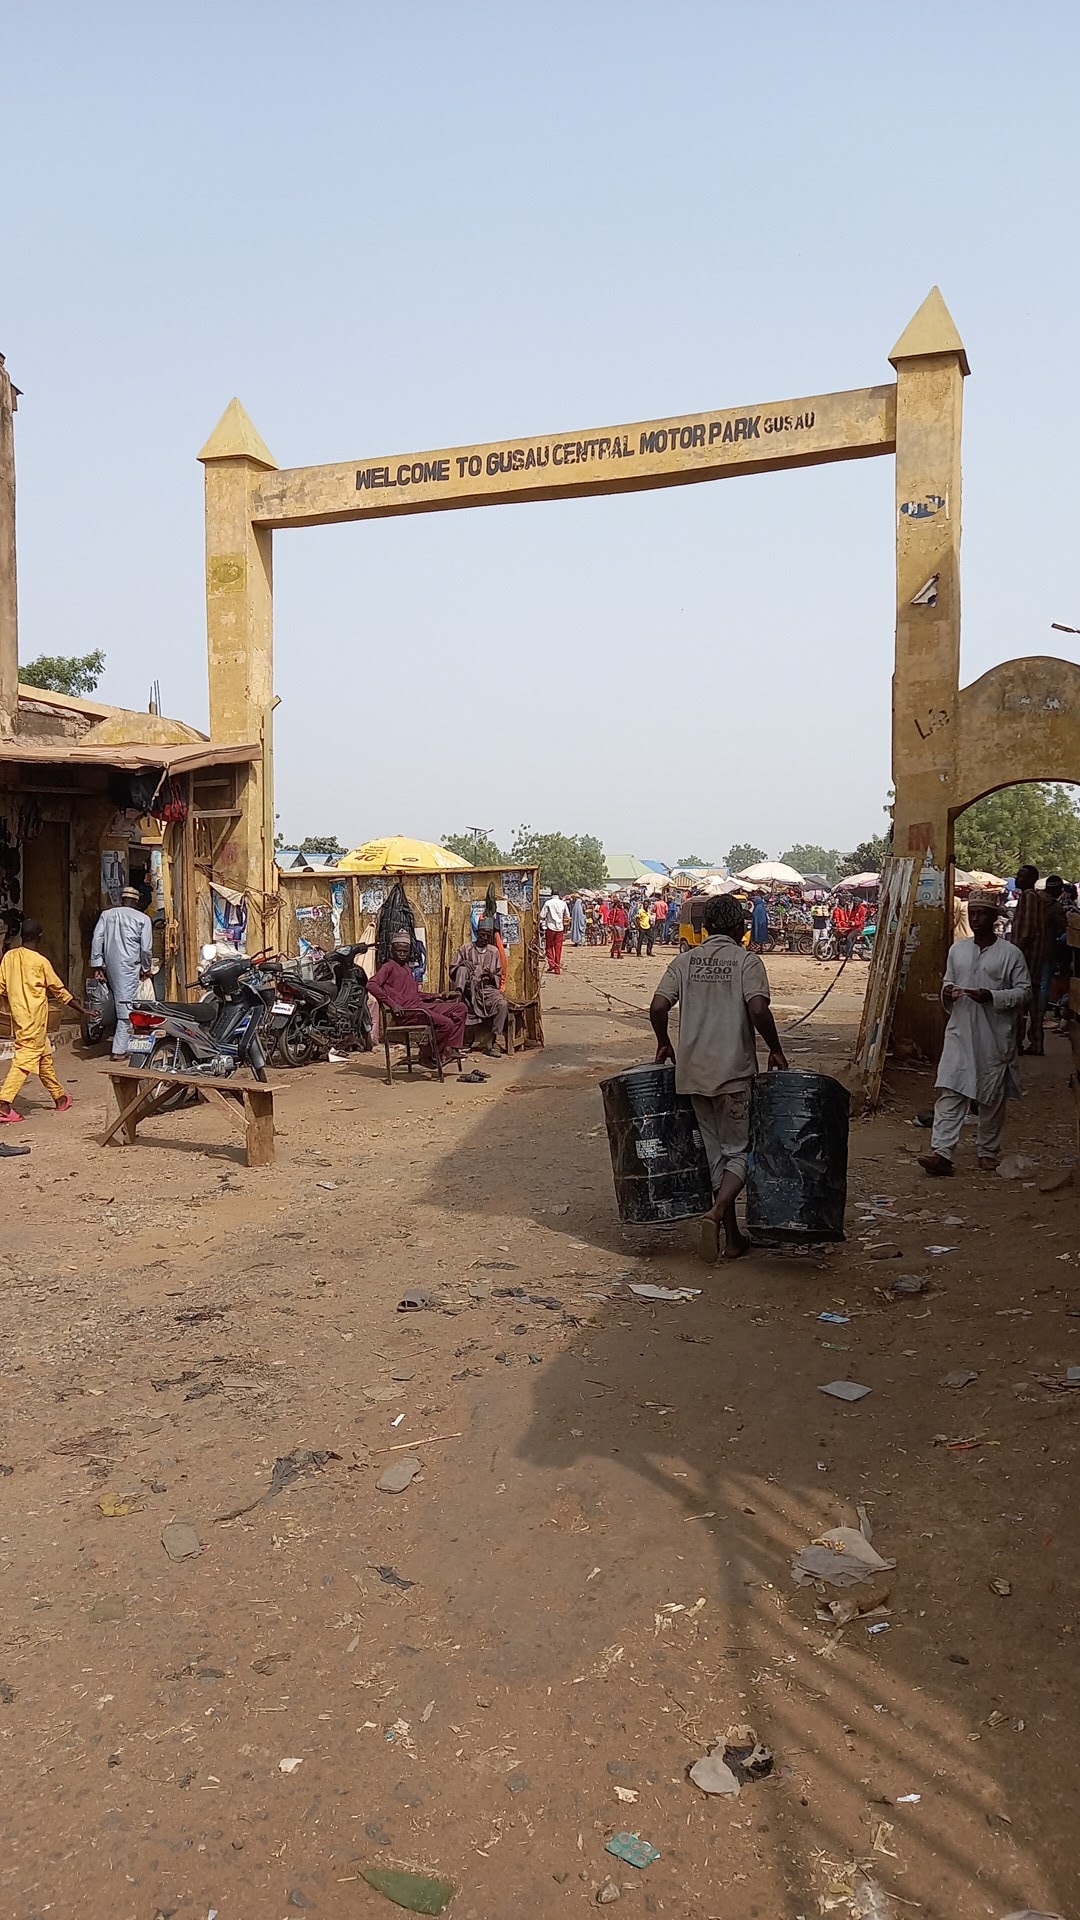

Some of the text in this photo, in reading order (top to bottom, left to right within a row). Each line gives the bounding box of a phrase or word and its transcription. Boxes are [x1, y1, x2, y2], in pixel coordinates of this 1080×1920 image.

[355, 411, 815, 490] WELCOME TO GUSAU CENTRAL MOTOR PARK GUSAU
[690, 957, 718, 966] BOXER
[695, 966, 731, 974] 7500
